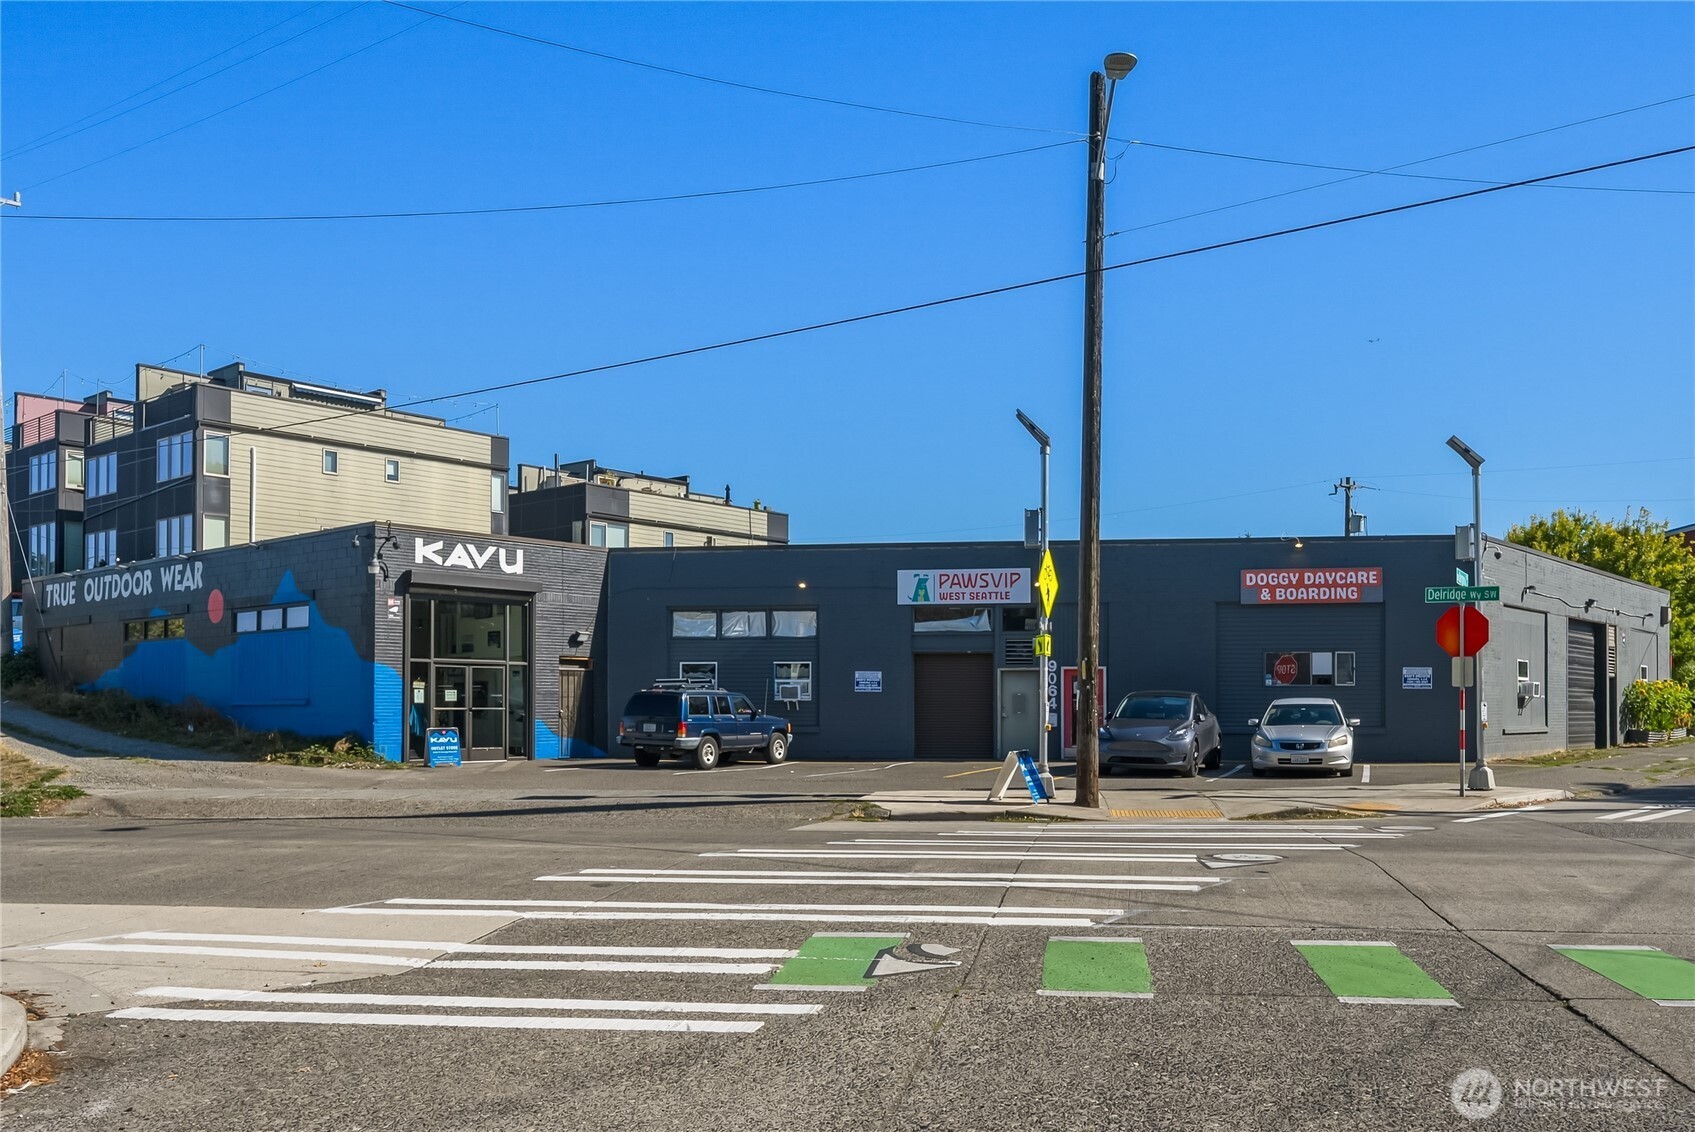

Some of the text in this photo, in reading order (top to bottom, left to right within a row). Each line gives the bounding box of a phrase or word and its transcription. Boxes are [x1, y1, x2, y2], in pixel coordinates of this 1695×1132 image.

[415, 538, 524, 574] KAVU
[46, 561, 203, 608] TRUE OUTDOOR WEAR
[939, 572, 1021, 589] PAWSVIP
[1246, 571, 1378, 586] DOGGY DAYCARE
[939, 591, 1011, 601] WEST SEATTLE
[1260, 587, 1358, 600] & BOARDING
[1427, 588, 1497, 601] Delridge Wy SW
[1048, 660, 1058, 710] 9064
